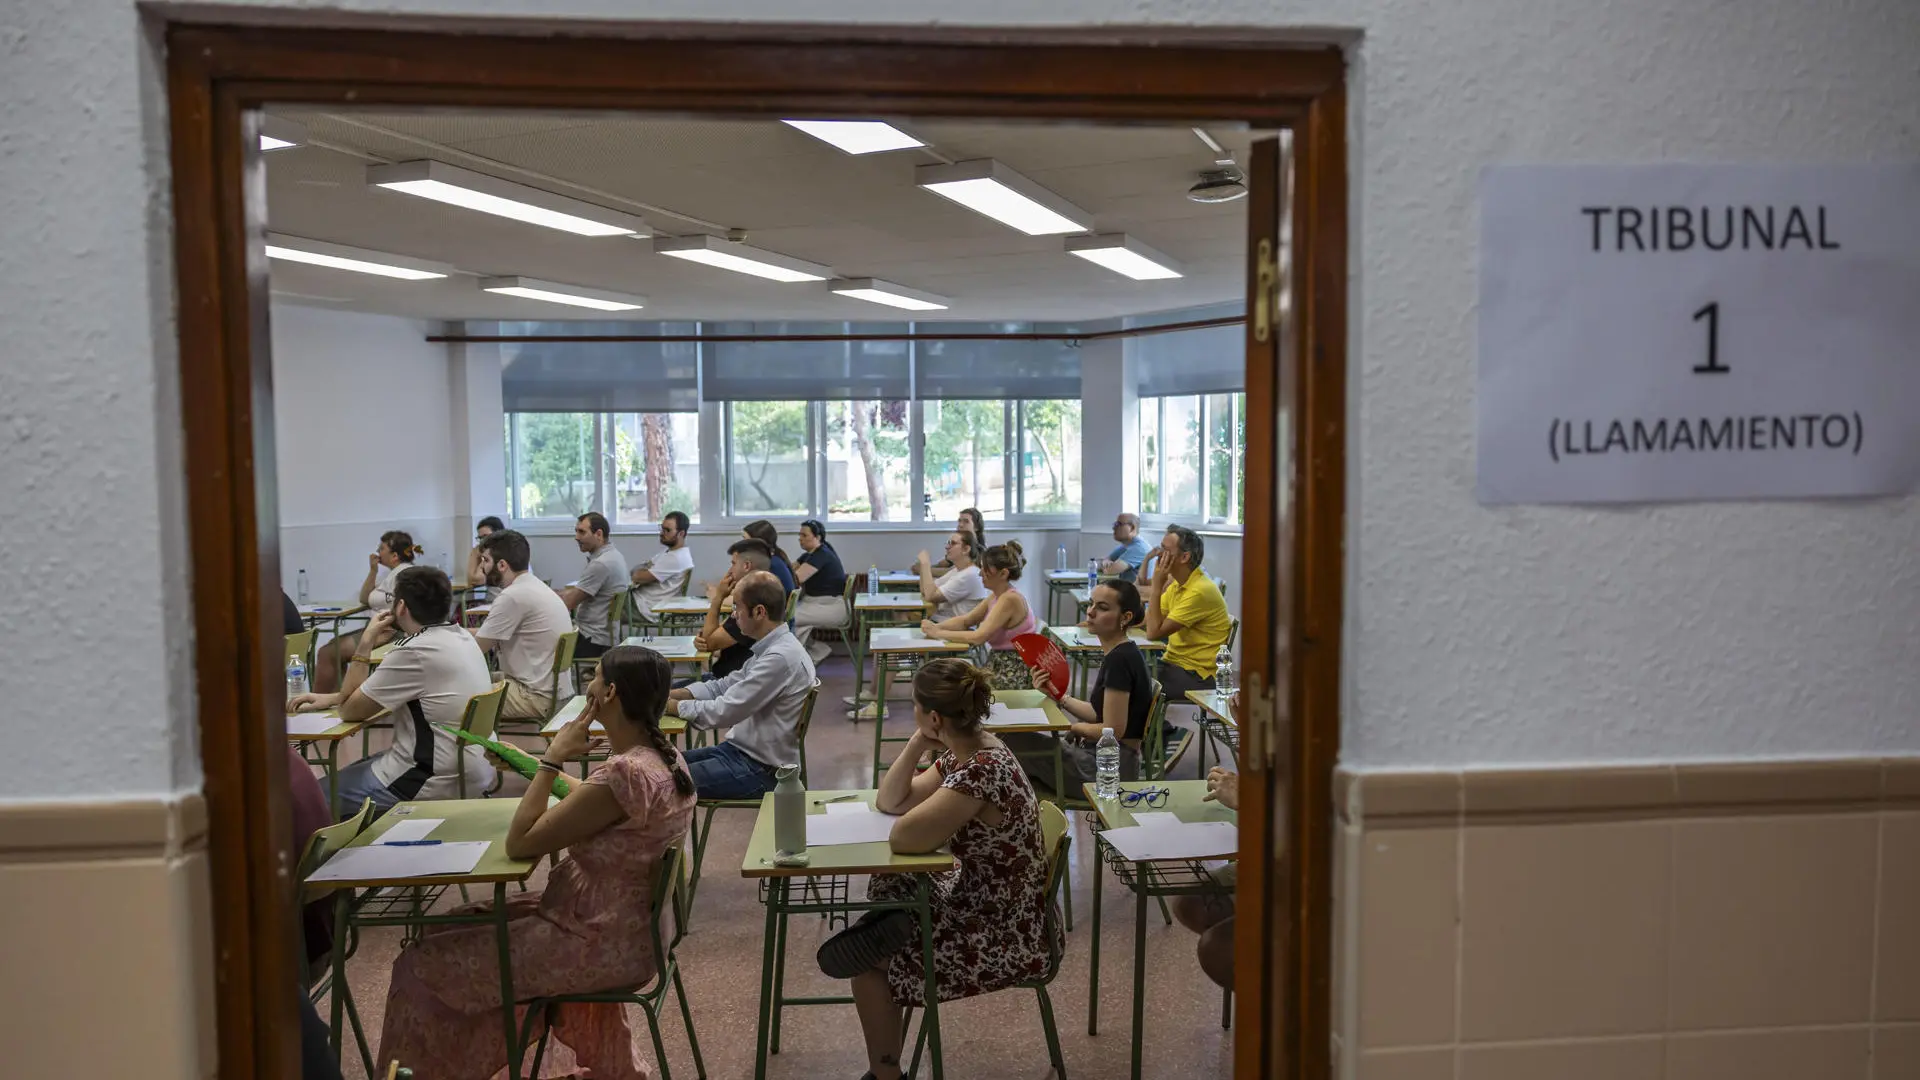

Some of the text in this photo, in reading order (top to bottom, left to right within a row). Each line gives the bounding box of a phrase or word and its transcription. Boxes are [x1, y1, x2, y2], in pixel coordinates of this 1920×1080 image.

[1581, 205, 1841, 252] TRIBUNAL
[1691, 301, 1731, 374] 1
[1548, 411, 1864, 463] (LLAMAMIENTO)
